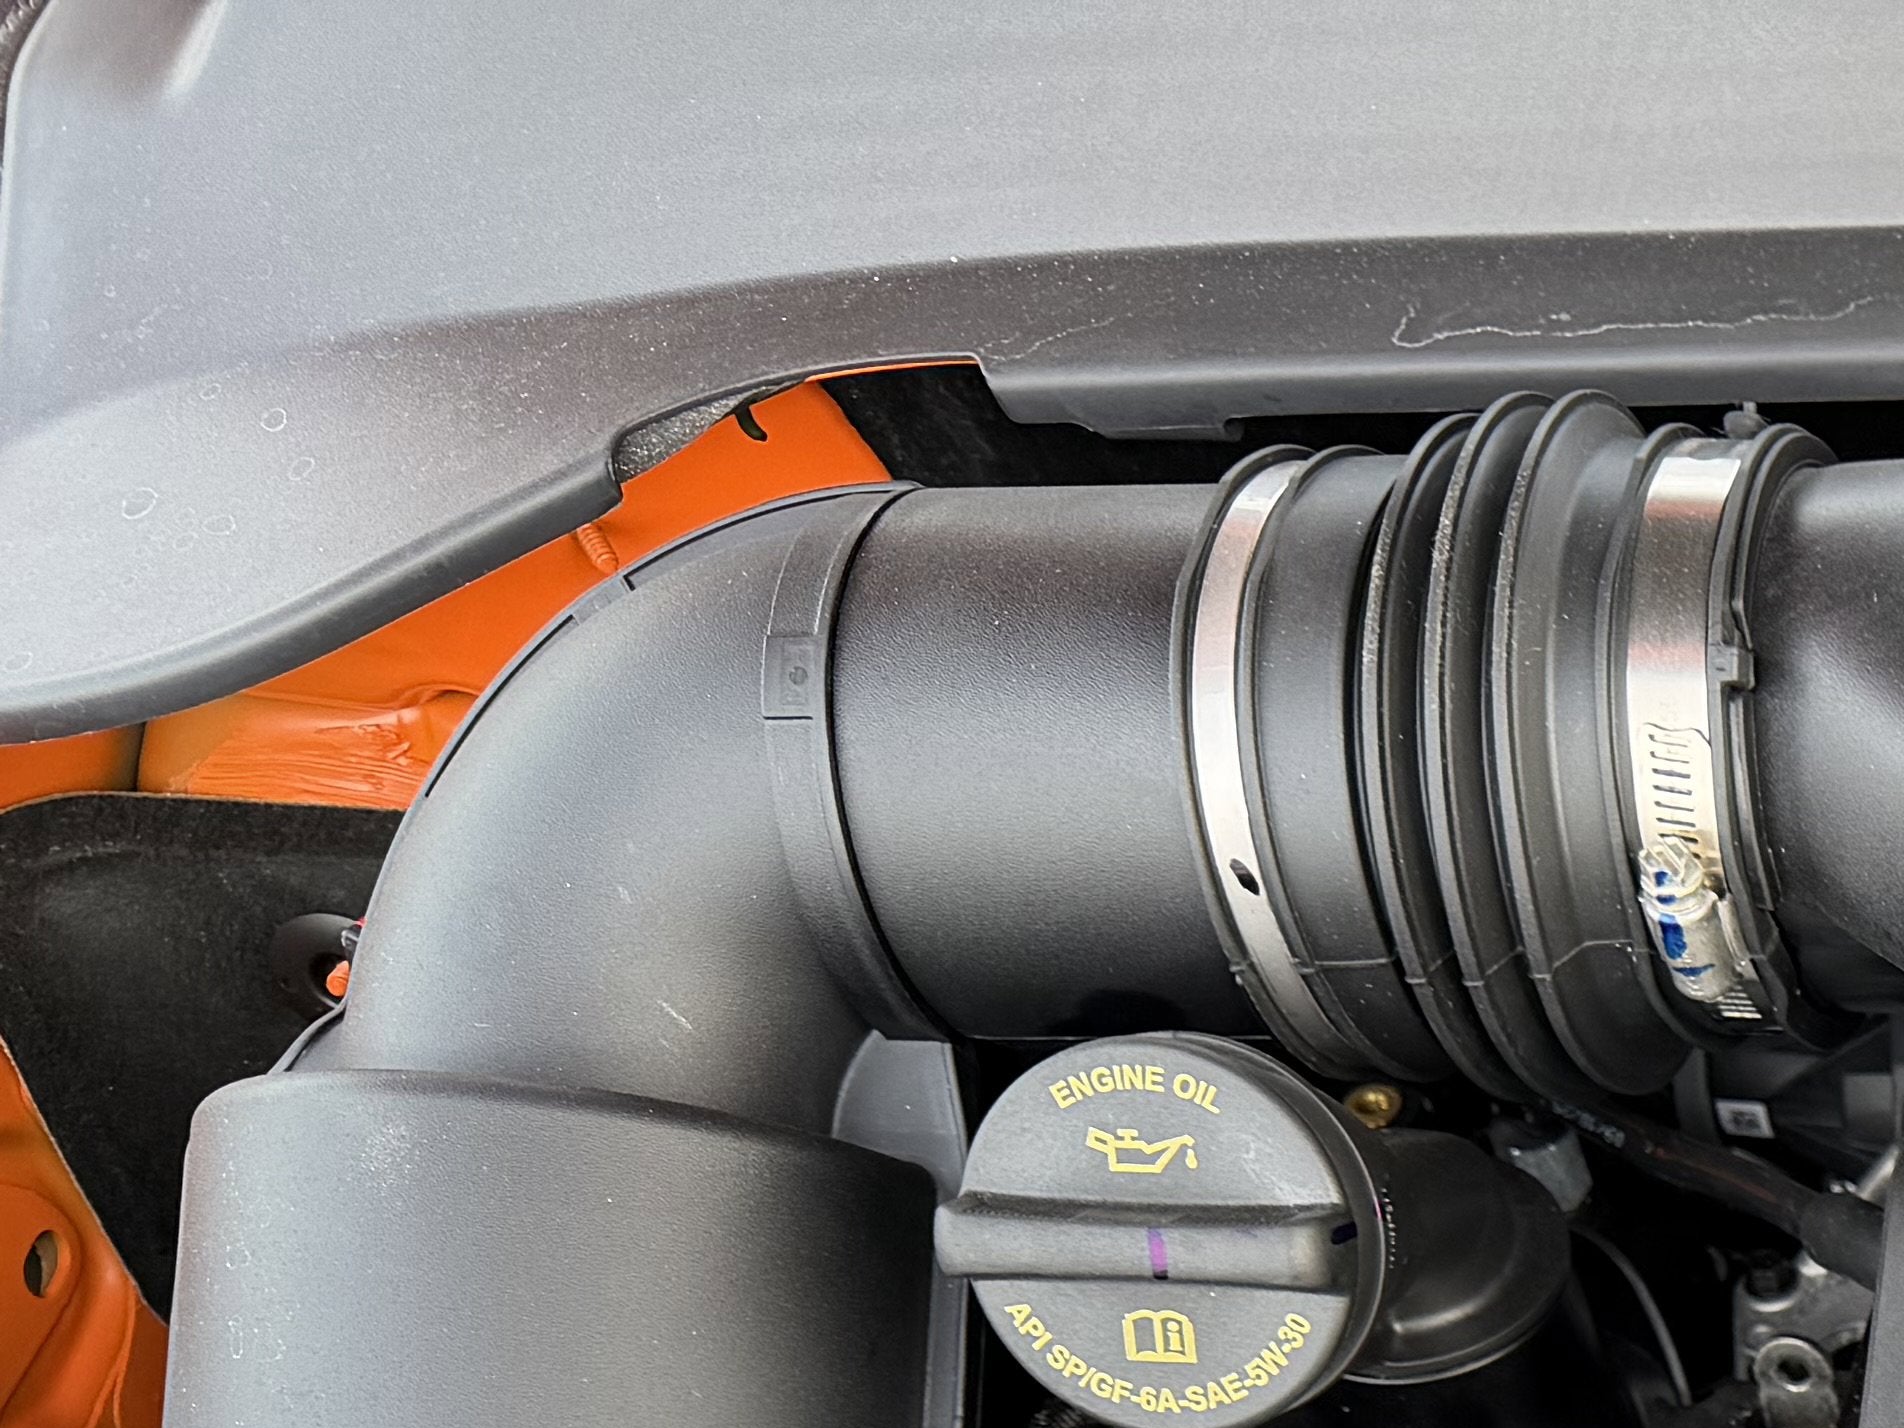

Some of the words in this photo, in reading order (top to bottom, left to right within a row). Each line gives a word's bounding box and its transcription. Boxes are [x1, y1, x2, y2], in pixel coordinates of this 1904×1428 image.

[1048, 1064, 1165, 1109] ENGINE
[1172, 1072, 1223, 1114] OIL
[1004, 1302, 1054, 1352] API
